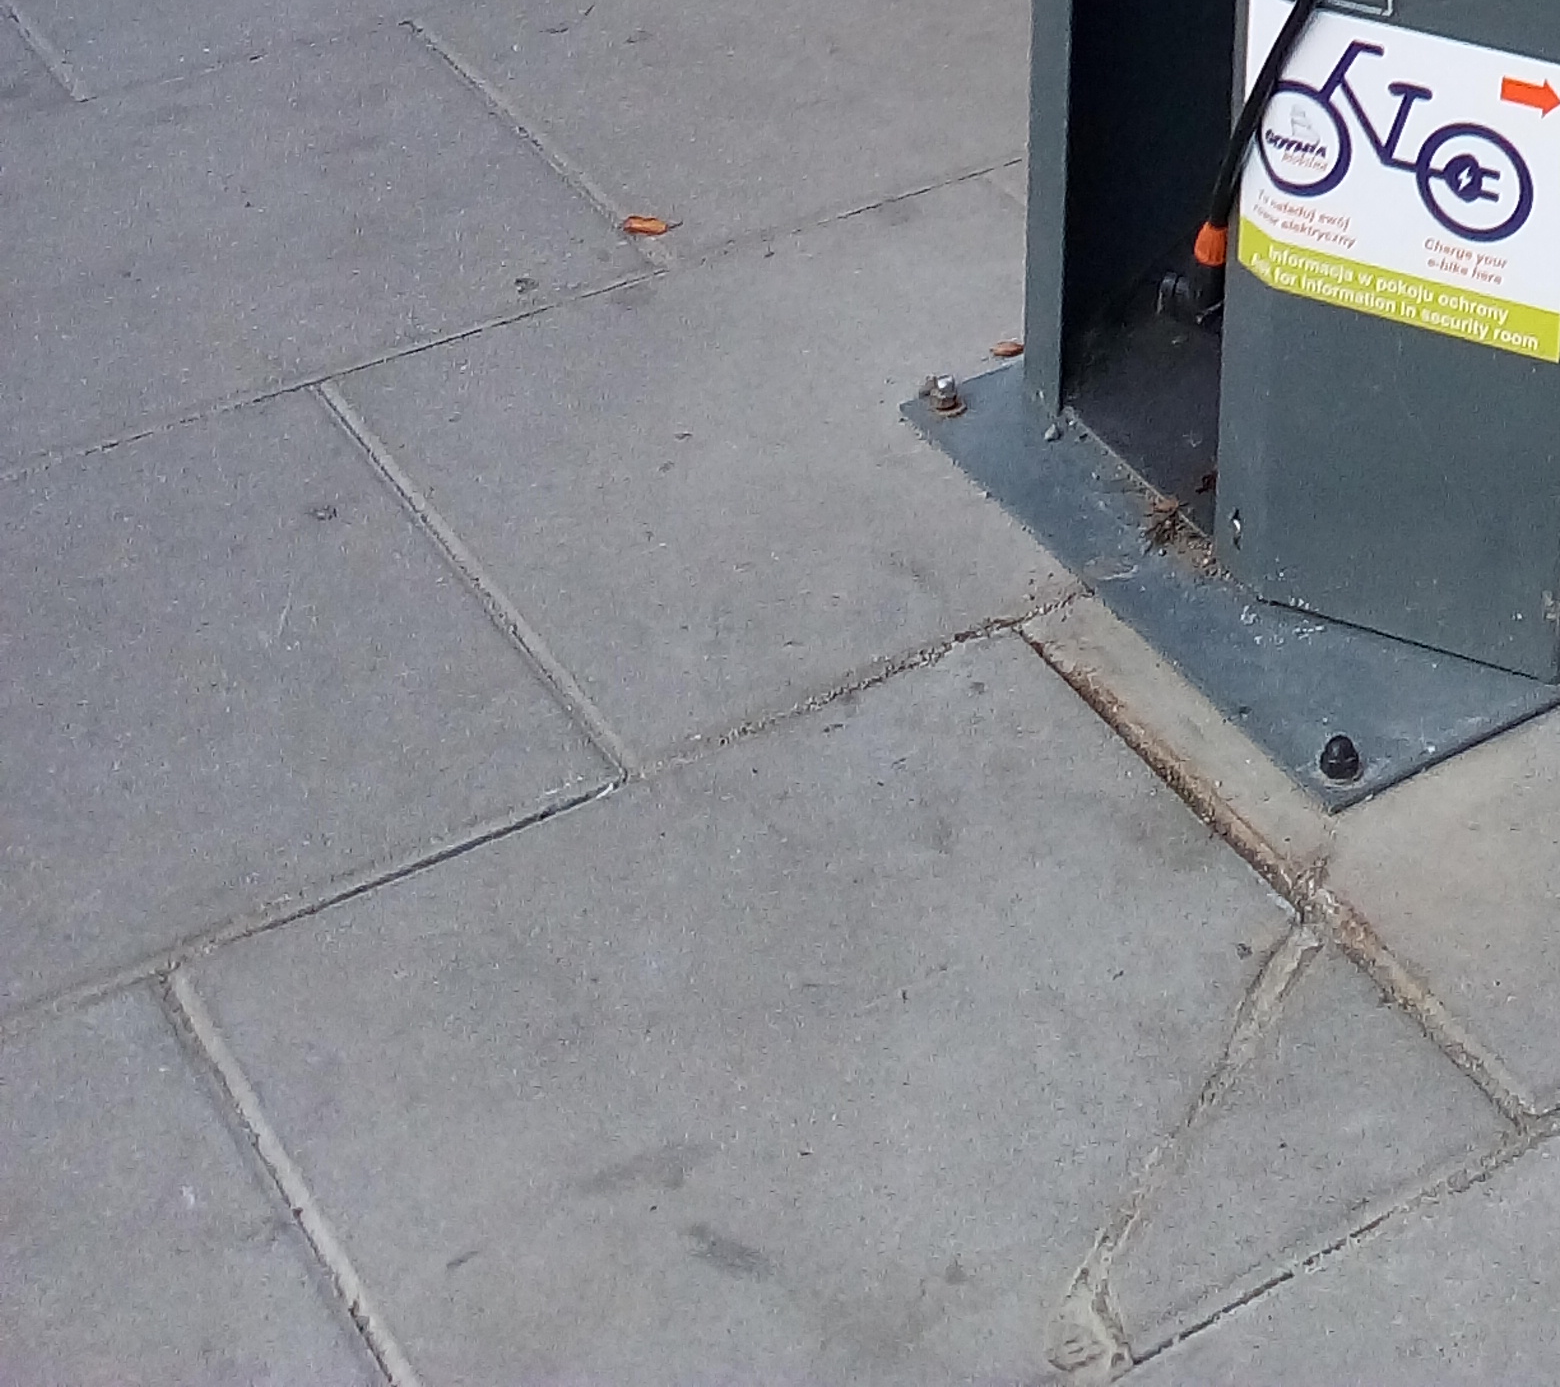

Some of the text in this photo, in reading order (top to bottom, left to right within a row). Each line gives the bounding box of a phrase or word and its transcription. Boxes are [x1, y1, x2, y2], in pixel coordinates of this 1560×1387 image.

[1424, 237, 1508, 269] Charge your
[1472, 267, 1503, 285] here
[1268, 244, 1510, 325] Informacja w pokoju ochrony
[1274, 266, 1298, 286] for
[1420, 307, 1490, 340] security
[1493, 326, 1539, 351] room
